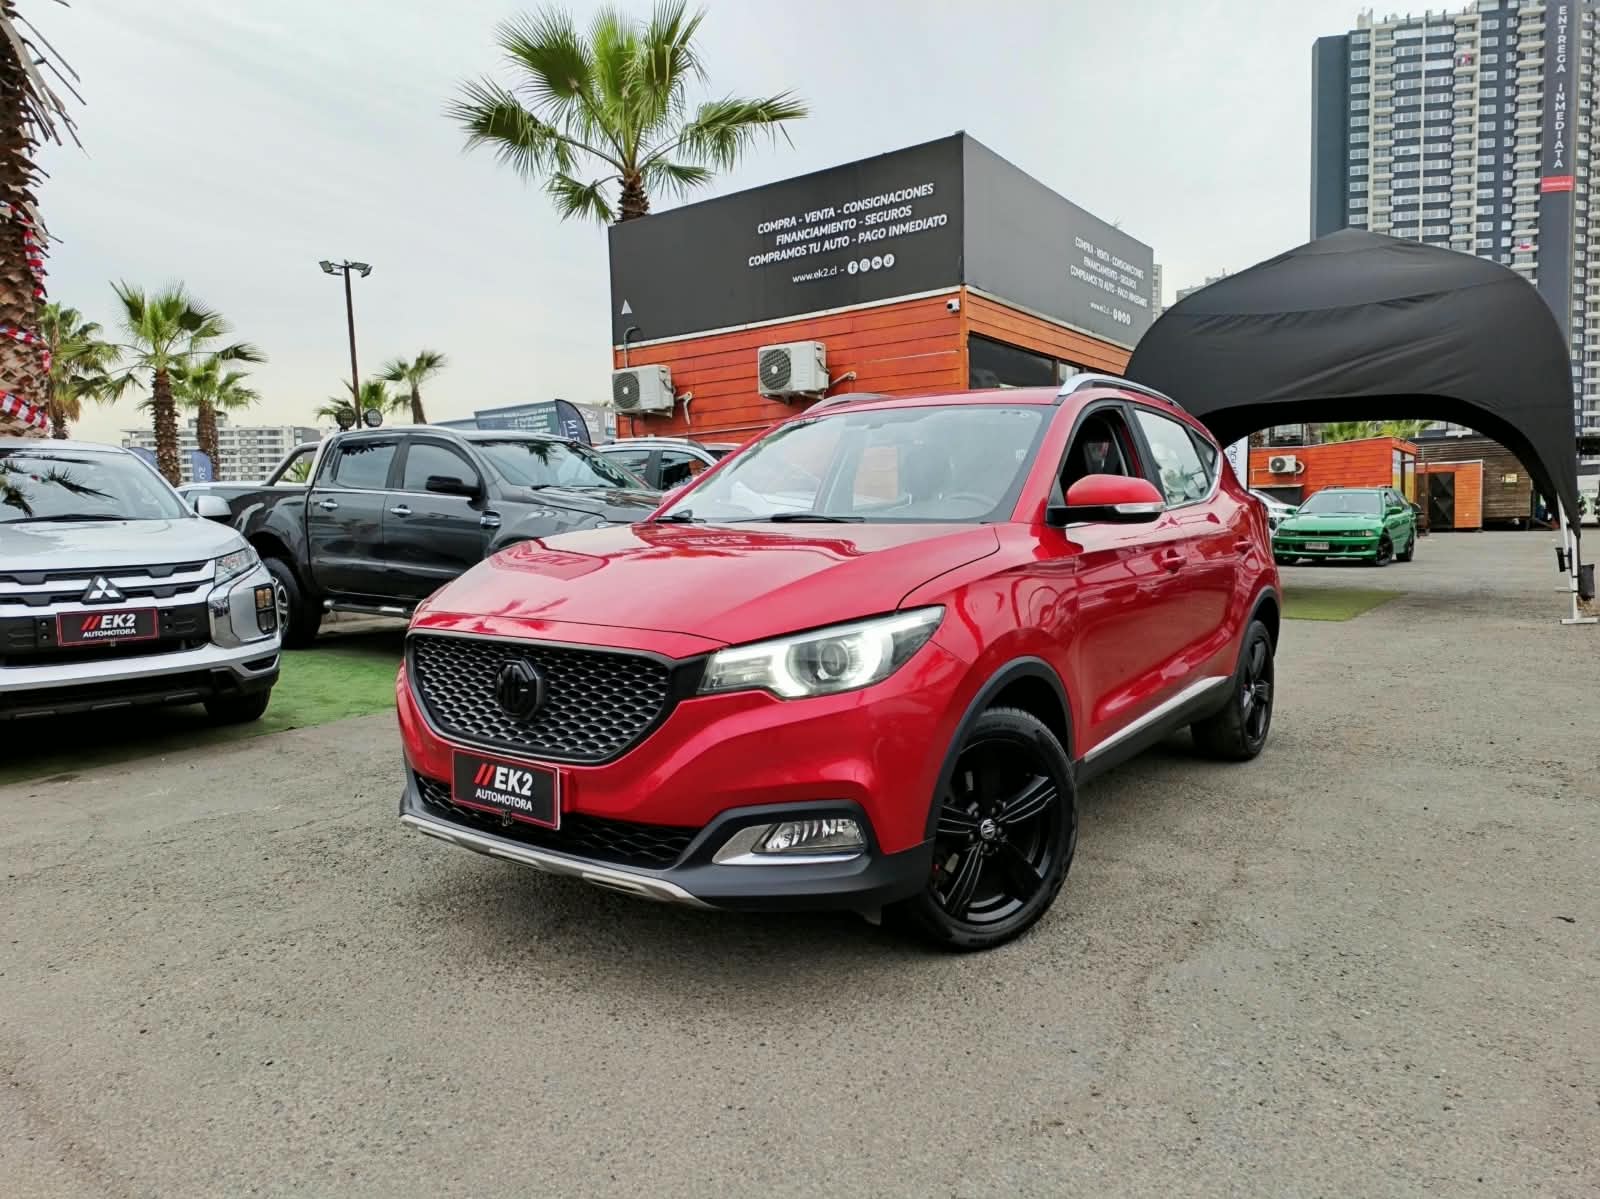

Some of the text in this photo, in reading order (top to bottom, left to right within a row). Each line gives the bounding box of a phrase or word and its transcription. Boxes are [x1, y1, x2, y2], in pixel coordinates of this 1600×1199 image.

[1553, 5, 1568, 168] ENTREGA INMEDIATA
[757, 216, 797, 234] COMPRA
[805, 207, 835, 224] VENTA
[843, 183, 934, 215] CONSIGNACIONES
[776, 217, 857, 246] FINANCIAMIENTO
[865, 205, 912, 226] SEGUROS
[748, 247, 807, 267] COMPRAMOS
[809, 241, 821, 254] TU
[823, 236, 850, 252] AUTO
[858, 228, 887, 244] PAGO
[888, 214, 947, 238] INMEDIATO
[792, 266, 838, 283] www.ek2.cl
[83, 628, 137, 638] AUTOMOTORA
[475, 788, 533, 812] AUTOMOTORA
